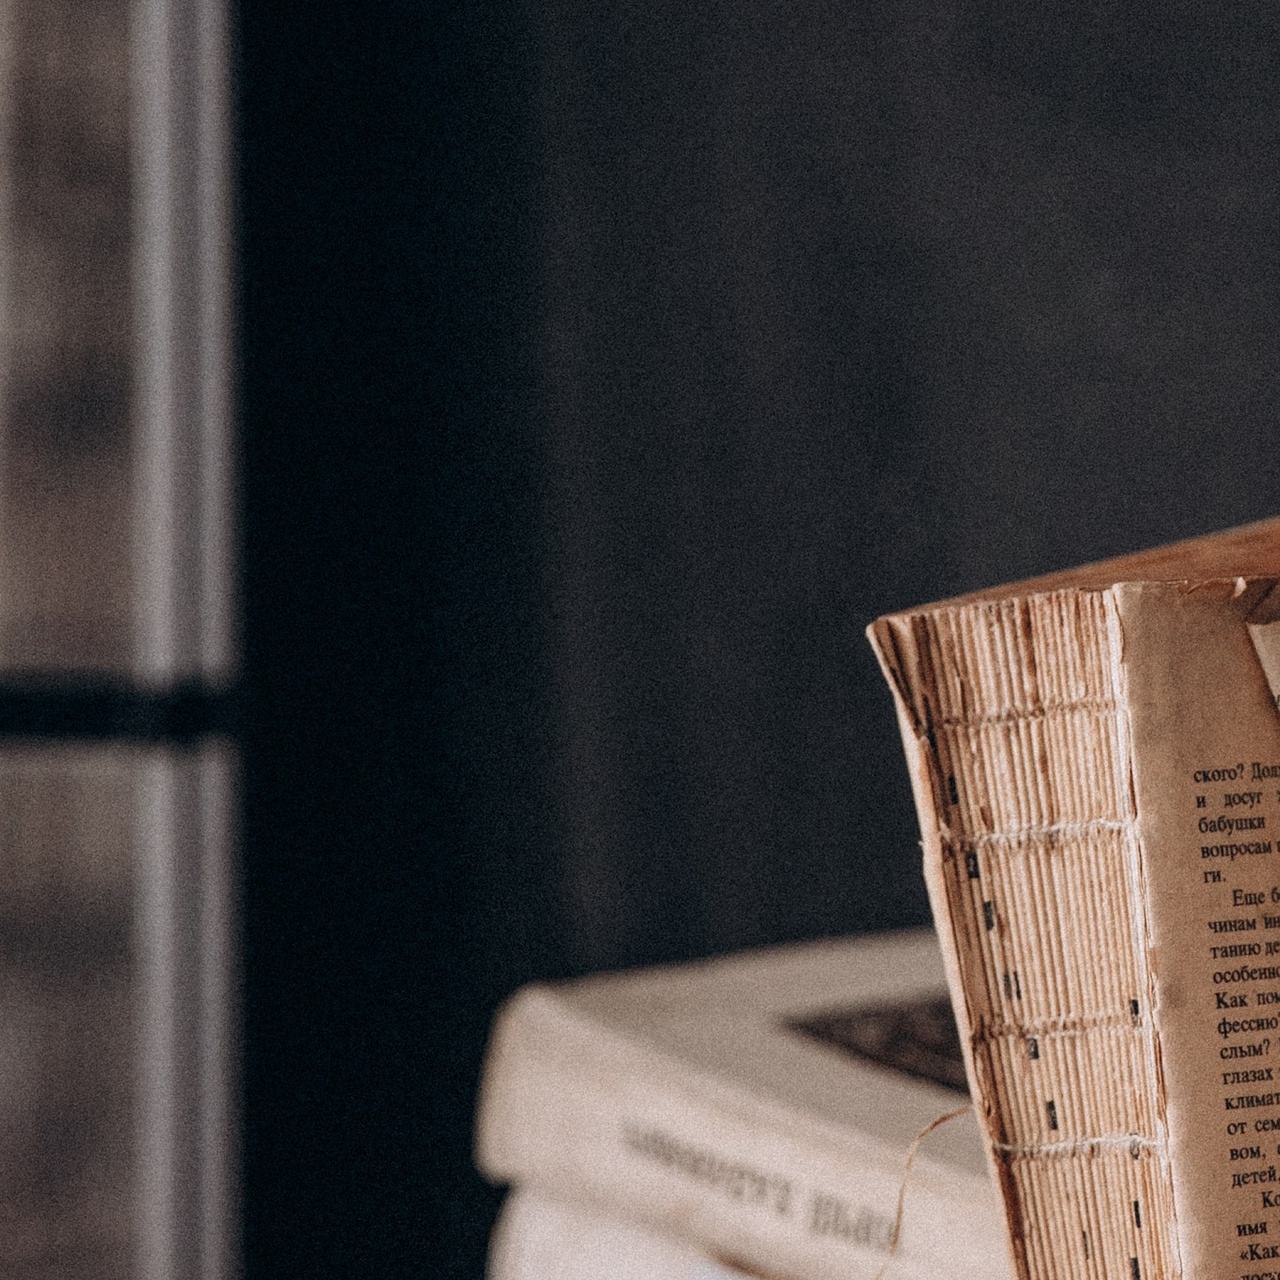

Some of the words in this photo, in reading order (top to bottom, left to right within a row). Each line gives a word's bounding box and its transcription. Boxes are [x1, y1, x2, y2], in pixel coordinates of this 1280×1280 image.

[1193, 763, 1245, 783] ского?
[1196, 796, 1206, 809] и
[1224, 790, 1262, 809] досуг
[1198, 812, 1266, 836] бабушки
[1201, 840, 1272, 862] вопросам
[1203, 870, 1226, 884] ги.
[1232, 888, 1266, 907] Еще
[1208, 917, 1257, 934] чинам
[1210, 942, 1261, 960] танию
[1215, 991, 1249, 1010] Как
[1219, 1038, 1271, 1060] слым?
[1222, 1068, 1274, 1085] глазах
[1226, 1120, 1248, 1136] от
[1229, 1146, 1267, 1162] вом,
[1236, 1222, 1268, 1237] имя
